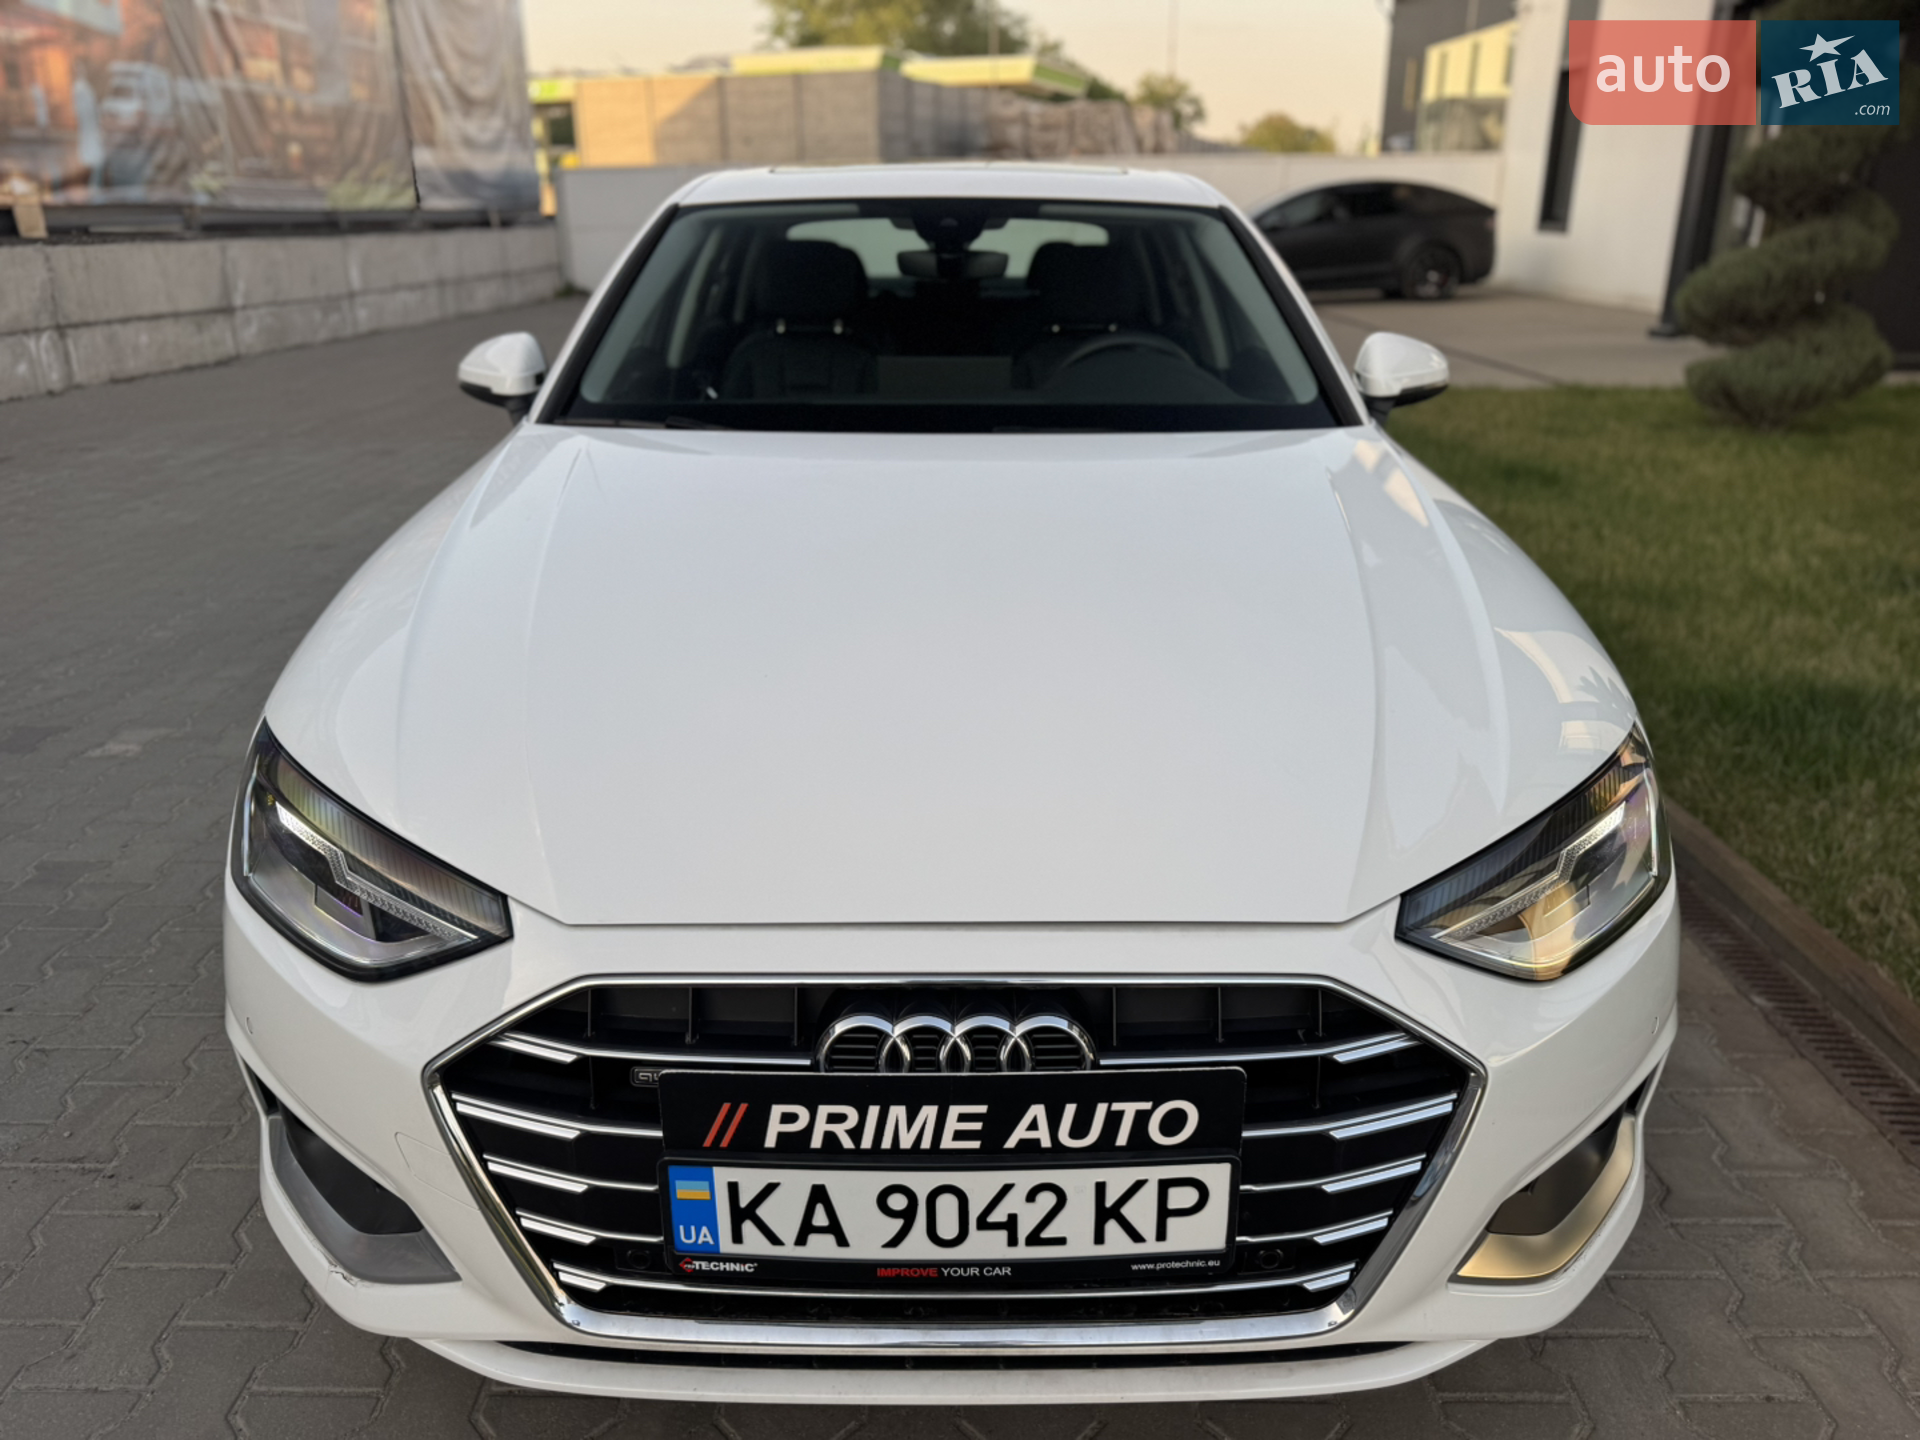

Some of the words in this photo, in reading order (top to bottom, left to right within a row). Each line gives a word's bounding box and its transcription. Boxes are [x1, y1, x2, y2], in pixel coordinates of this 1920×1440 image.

[763, 1104, 989, 1149] PRIME
[1003, 1099, 1200, 1149] AUTO
[727, 1181, 851, 1248] KA
[876, 1182, 1067, 1248] 9042
[1093, 1177, 1210, 1244] KP
[679, 1225, 715, 1246] UA
[876, 1266, 938, 1278] IMPROVE
[941, 1266, 980, 1277] YOUR
[983, 1265, 1012, 1277] CAR
[1130, 1259, 1221, 1271] www.protechnic.eu
